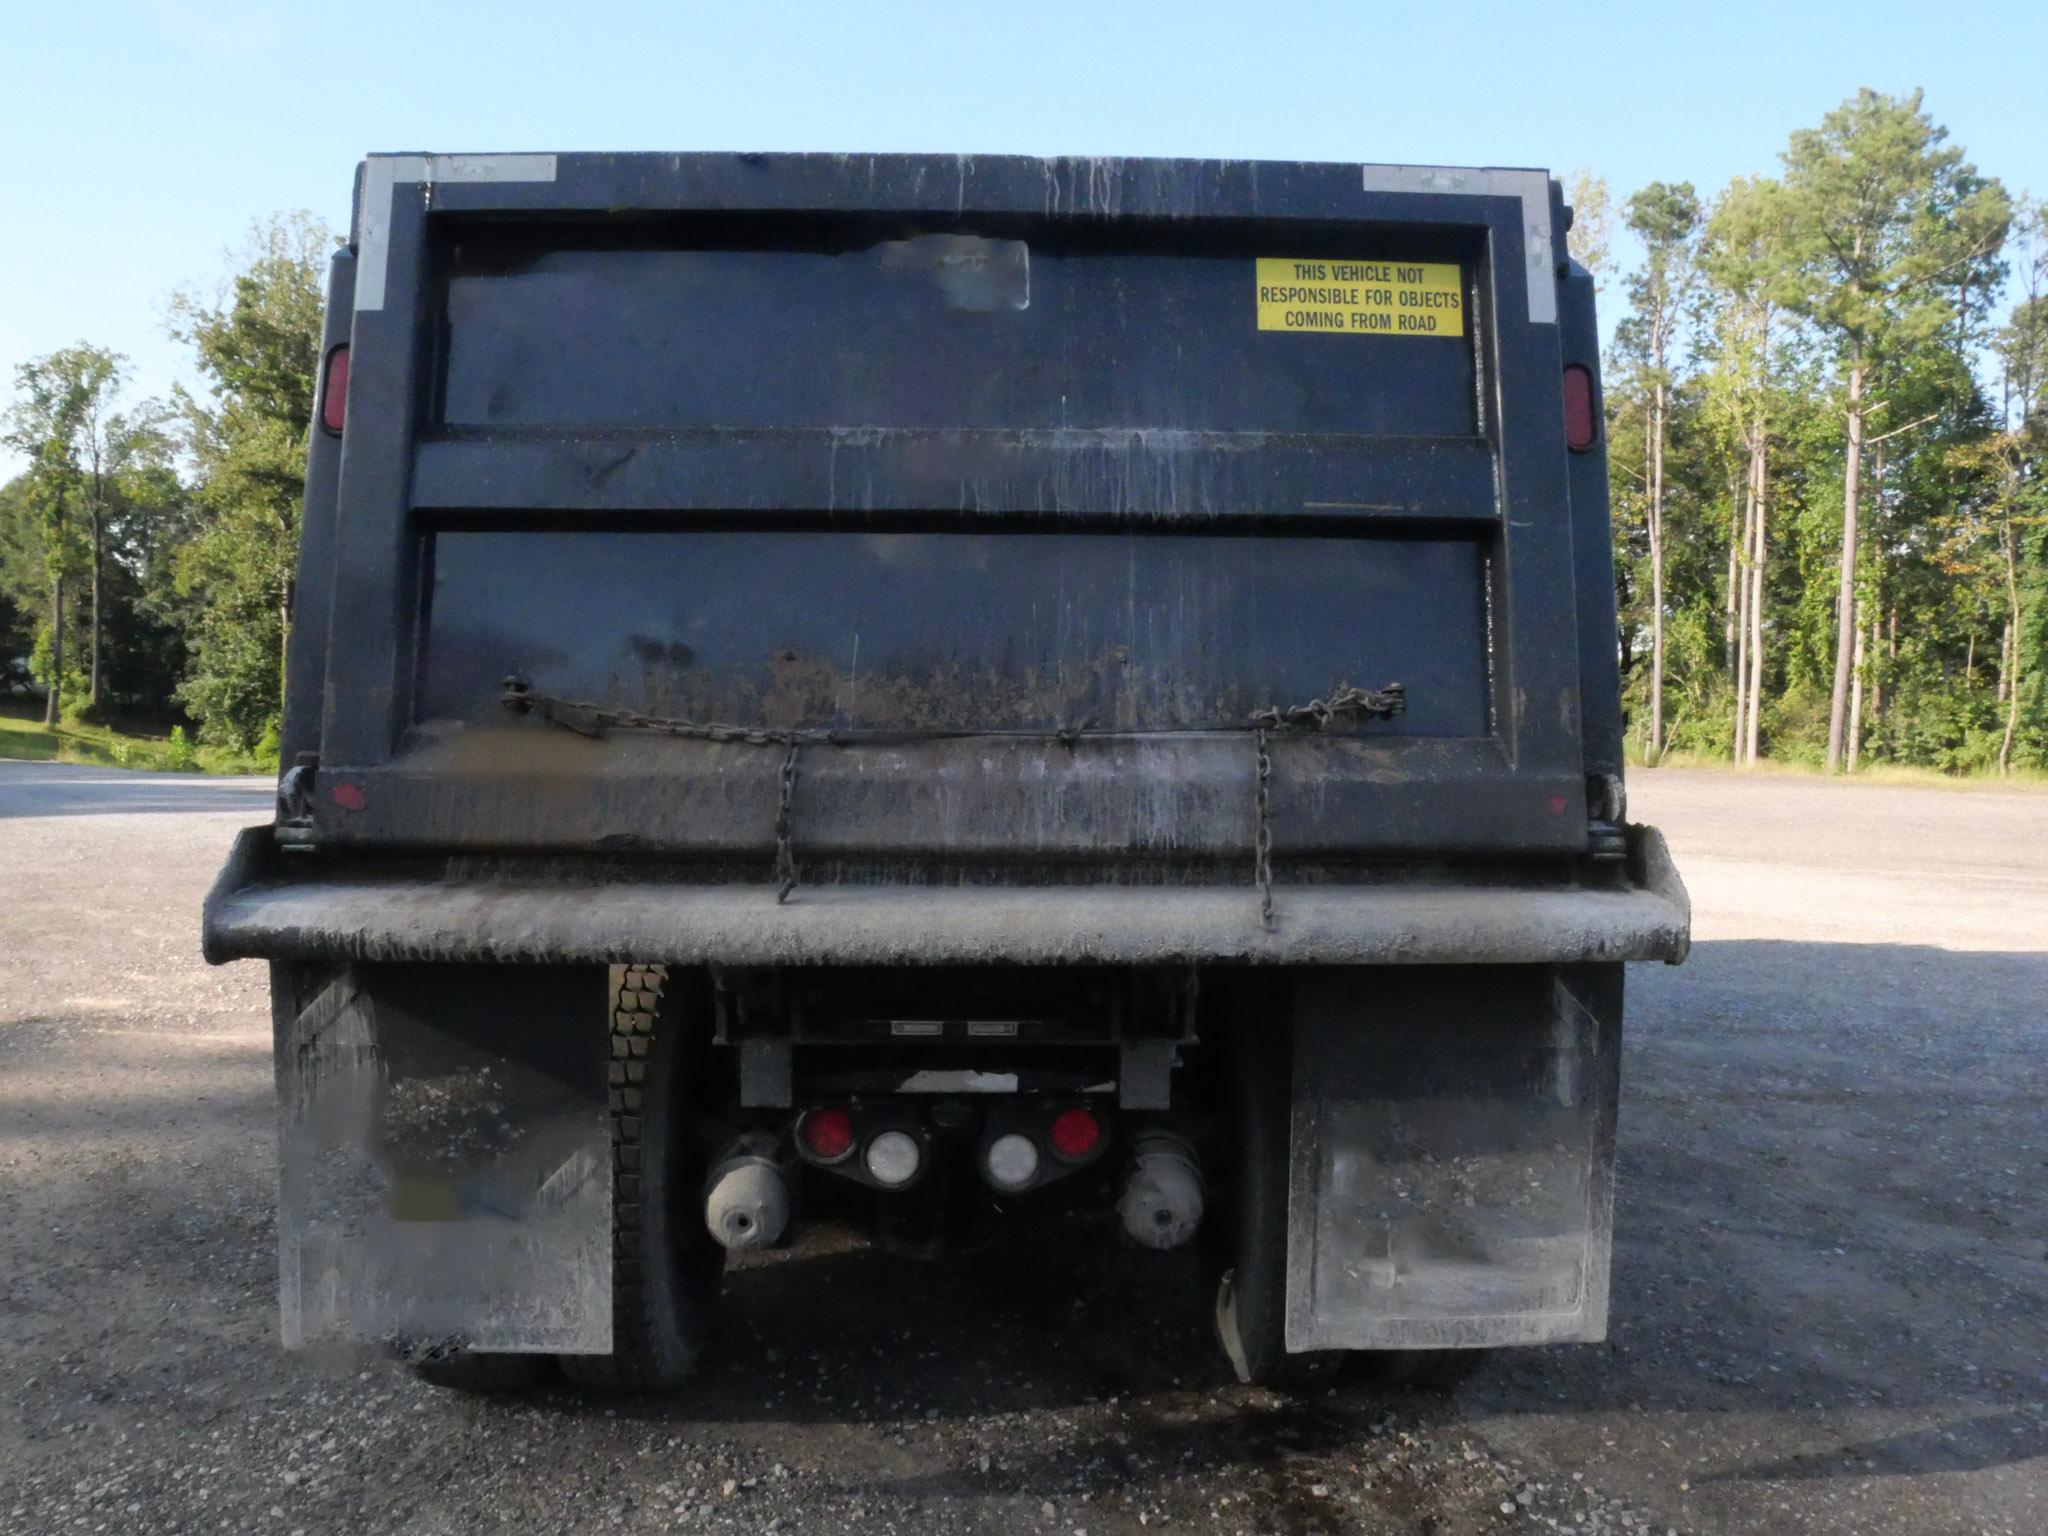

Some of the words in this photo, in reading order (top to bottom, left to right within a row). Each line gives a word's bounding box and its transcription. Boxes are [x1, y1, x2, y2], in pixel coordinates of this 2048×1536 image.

[1294, 264, 1326, 280] THIS
[1332, 266, 1391, 282] VEHICLE
[1397, 267, 1424, 284] NOT
[1260, 287, 1359, 305] RESPONSIBLE
[1365, 289, 1393, 306] FOR
[1400, 291, 1460, 308] OBJECTS
[1285, 311, 1344, 328] COMING
[1351, 312, 1392, 330] FROM
[1399, 315, 1437, 331] ROAD
